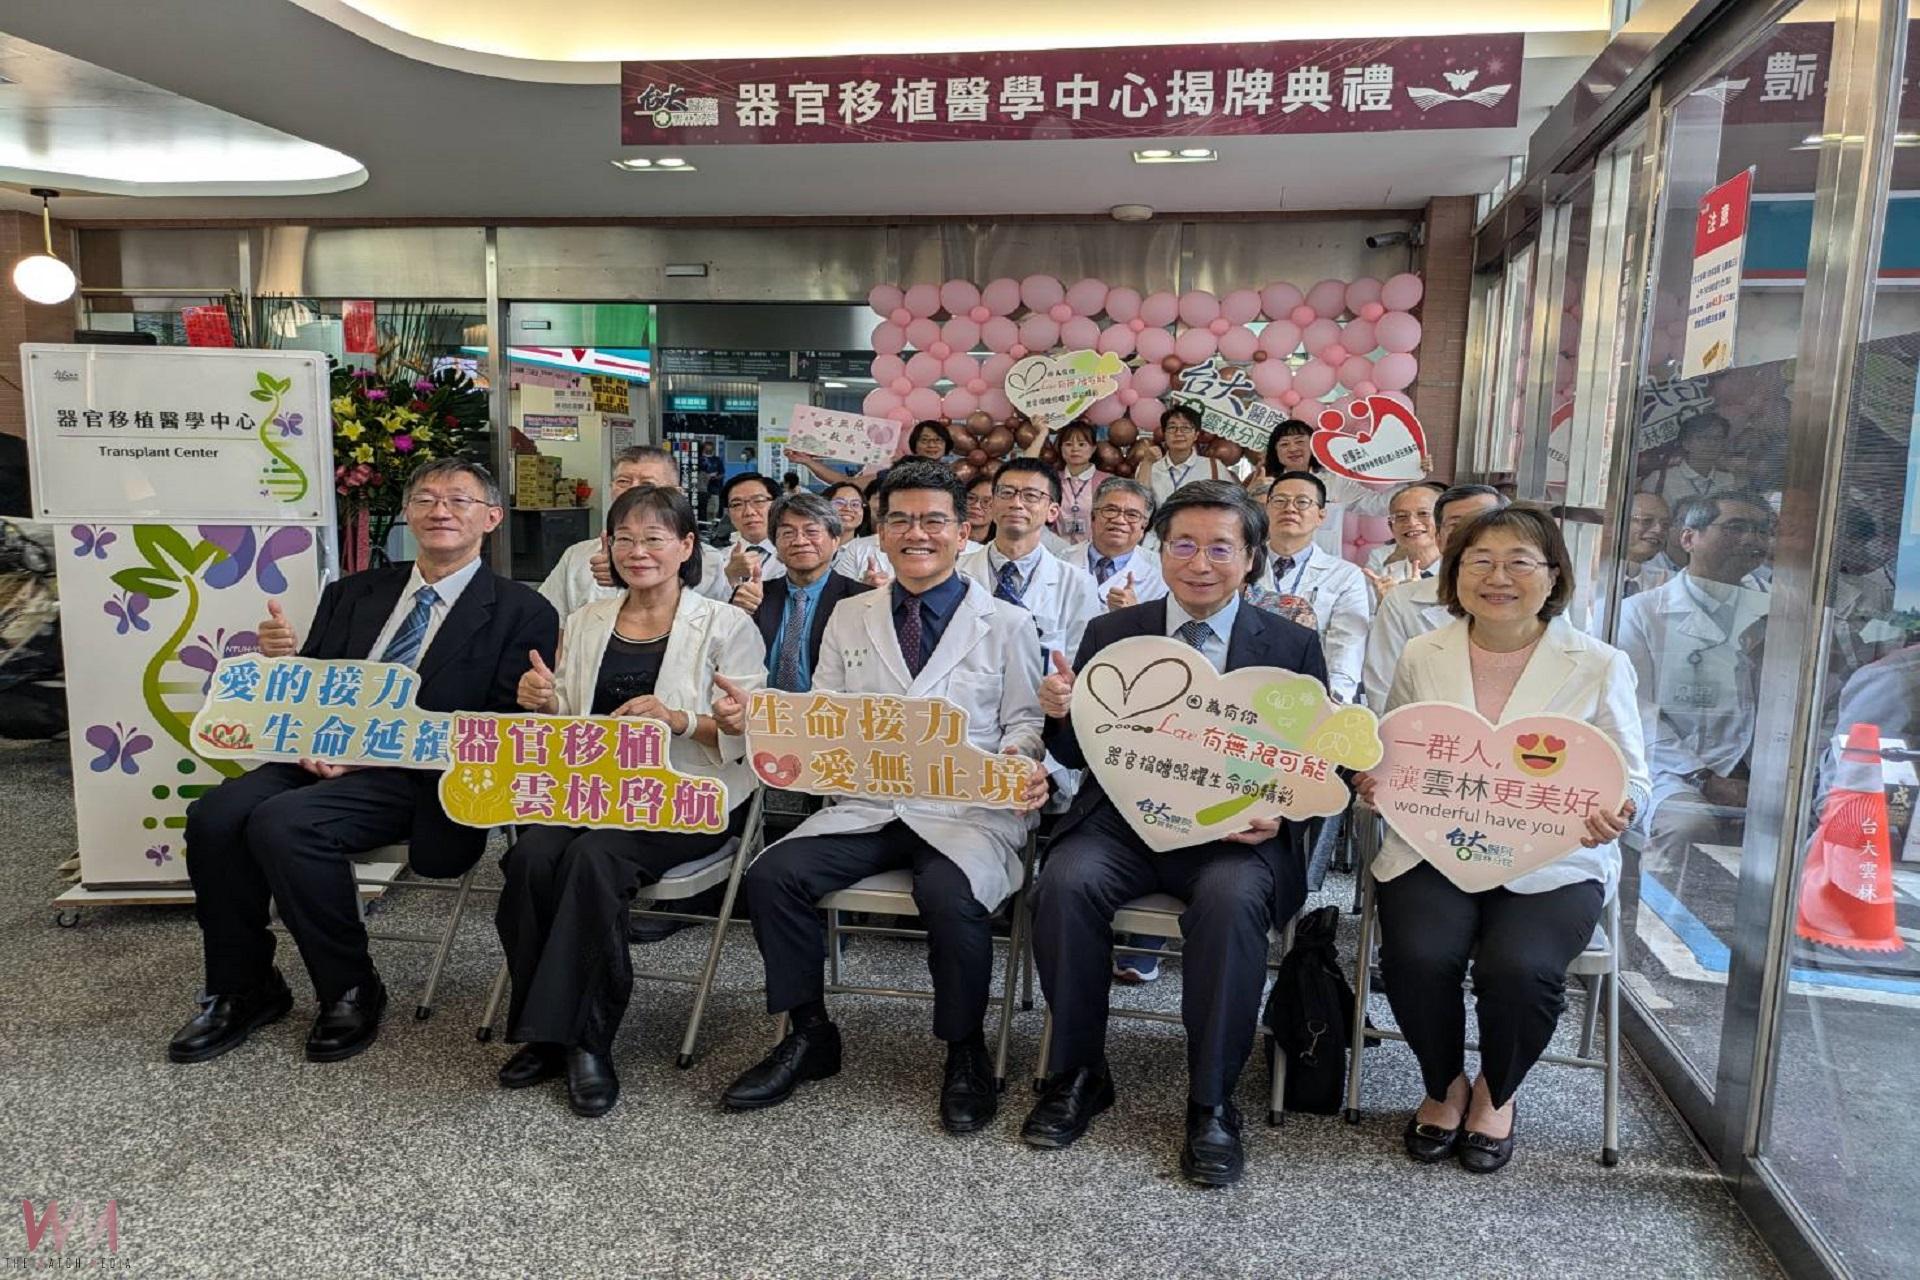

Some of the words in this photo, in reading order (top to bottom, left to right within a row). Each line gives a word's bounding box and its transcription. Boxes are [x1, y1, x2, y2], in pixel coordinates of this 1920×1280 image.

[736, 64, 1394, 127] 器官移植醫學中心揭牌典禮
[57, 409, 256, 430] 器官移植醫學中心
[99, 446, 170, 459] Transplant
[174, 448, 218, 458] Center
[215, 661, 414, 710] 愛的接力
[261, 713, 450, 762] 生命延續
[454, 718, 663, 769] 器官移植
[750, 694, 965, 746] 生命接力
[810, 747, 1029, 803] 愛無止境
[1389, 764, 1600, 819] 讓雲林更美好
[1394, 799, 1480, 823] wonderful
[1485, 809, 1527, 831] have
[1530, 820, 1566, 837] you
[1858, 815, 1880, 903] 台大雲林
